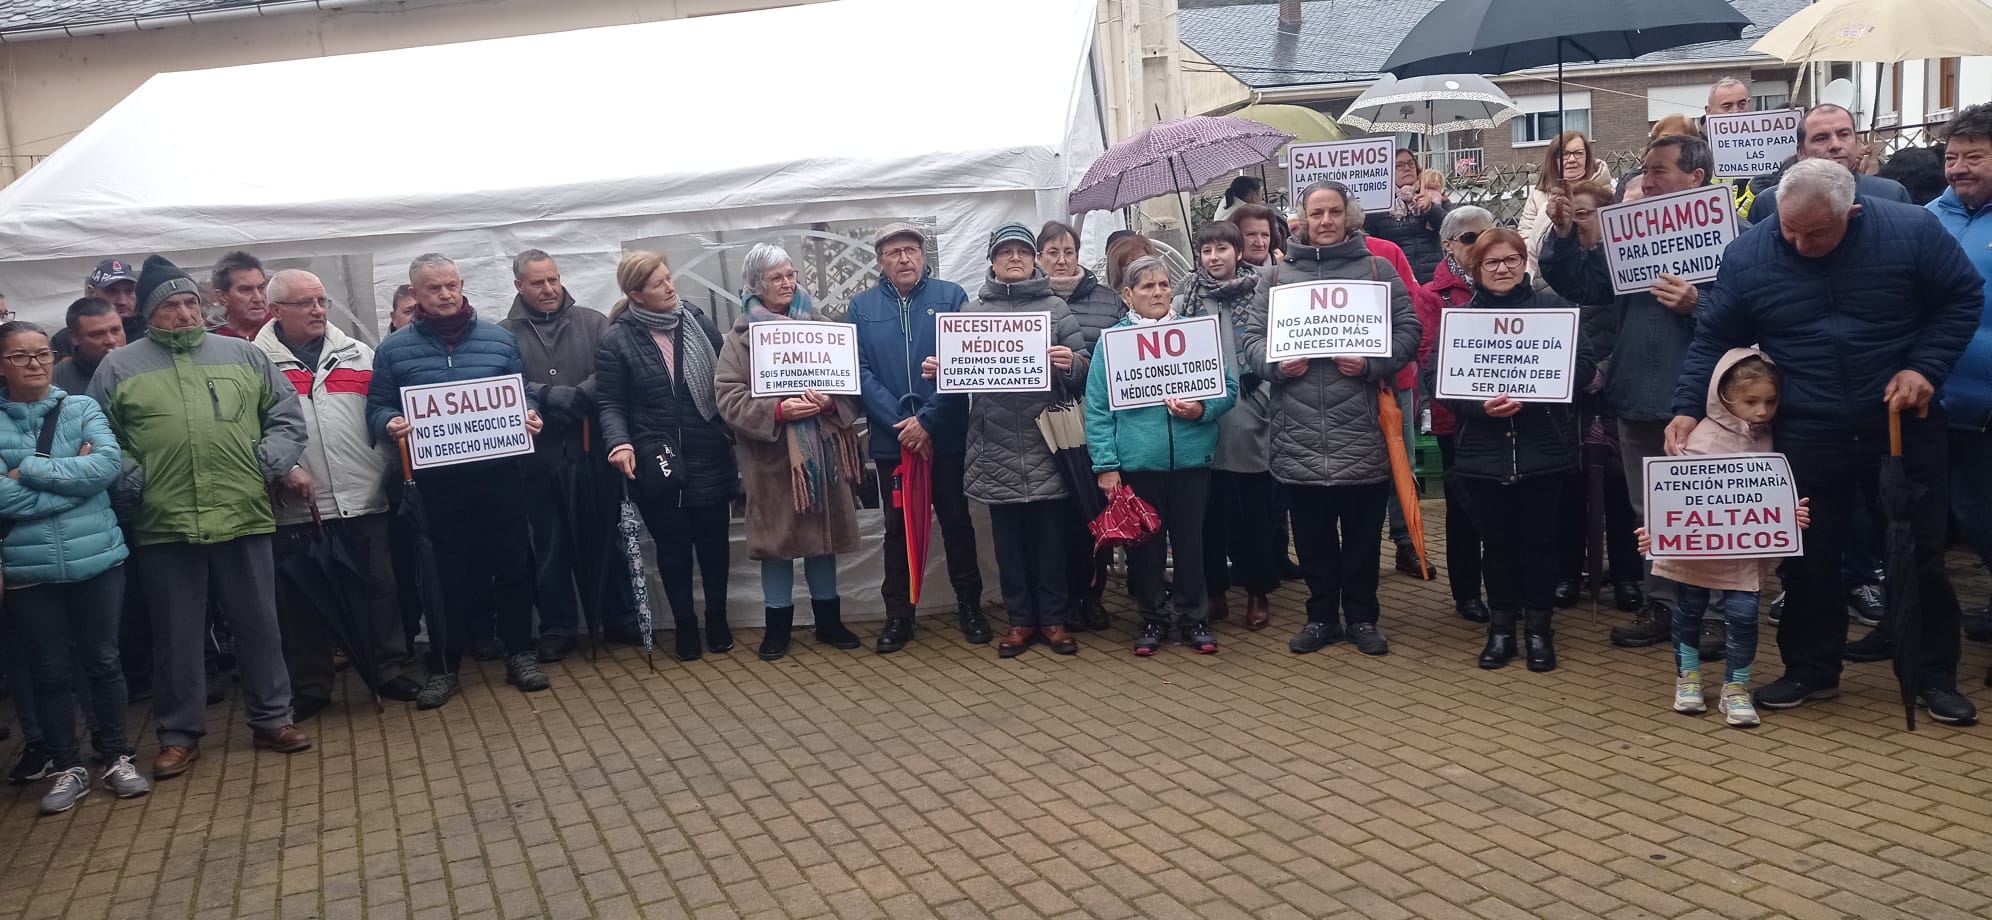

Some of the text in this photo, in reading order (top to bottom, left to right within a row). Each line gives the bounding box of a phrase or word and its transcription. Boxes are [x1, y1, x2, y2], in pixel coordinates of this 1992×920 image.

[1714, 117, 1796, 134] IGUALDAD
[1718, 136, 1795, 148] DE TRATO PARA
[1295, 147, 1387, 169] SALVEMOS
[1746, 151, 1764, 159] LAS
[1296, 168, 1388, 182] LA ATENCIÓN PRIMARIA
[1719, 164, 1748, 172] ZONAS
[1609, 196, 1724, 242] LUCHAMOS
[1619, 231, 1722, 261] PARA DEFENDER
[1618, 254, 1722, 284] NUESTRA SANIDA
[1311, 287, 1348, 310] NO
[943, 320, 1042, 332] NECESITAMOS
[1277, 315, 1382, 328] NOS ABANDONEN
[1494, 318, 1524, 334] NO
[760, 328, 845, 345] MÉDICOS DE
[1289, 324, 1368, 338] CUANDO MÁS
[962, 336, 1023, 353] MÉDICOS
[1137, 329, 1186, 361] NO
[1276, 339, 1381, 352] LO NECESITAMOS
[1453, 337, 1562, 349] ELEGIMOS QUE DÍA
[773, 352, 832, 364] FAMILIA
[1000, 356, 1019, 364] QUE
[1474, 354, 1539, 364] ENFERMAR
[760, 369, 850, 378] SOIS FUNDAMENTALES
[944, 366, 984, 375] CUBRÁN
[1024, 366, 1043, 374] LAS
[1116, 359, 1217, 382] A LOS CONSULTORIOS
[1450, 367, 1561, 379] LA ATENCIÓN DEBE
[773, 380, 845, 388] IMPRESCINDIBLES
[946, 377, 1040, 386] PLAZAS VACANTES
[1472, 383, 1536, 393] SER DIARIA
[1121, 378, 1216, 400] MÉDICOS CERRADOS
[411, 385, 517, 419] LA SALUD
[416, 415, 521, 440] NO ES UN NEGOCIO ES
[417, 433, 526, 459] UN DERECHO HUMANO
[656, 455, 671, 477] FILA
[1670, 462, 1772, 475] QUEREMOS UNA
[1654, 474, 1788, 491] ATENCIÓN PRIMARÍA
[1685, 493, 1763, 505] DE CALIDAD
[1666, 507, 1781, 527] FALTAN
[1659, 529, 1789, 550] MÉDICOS
